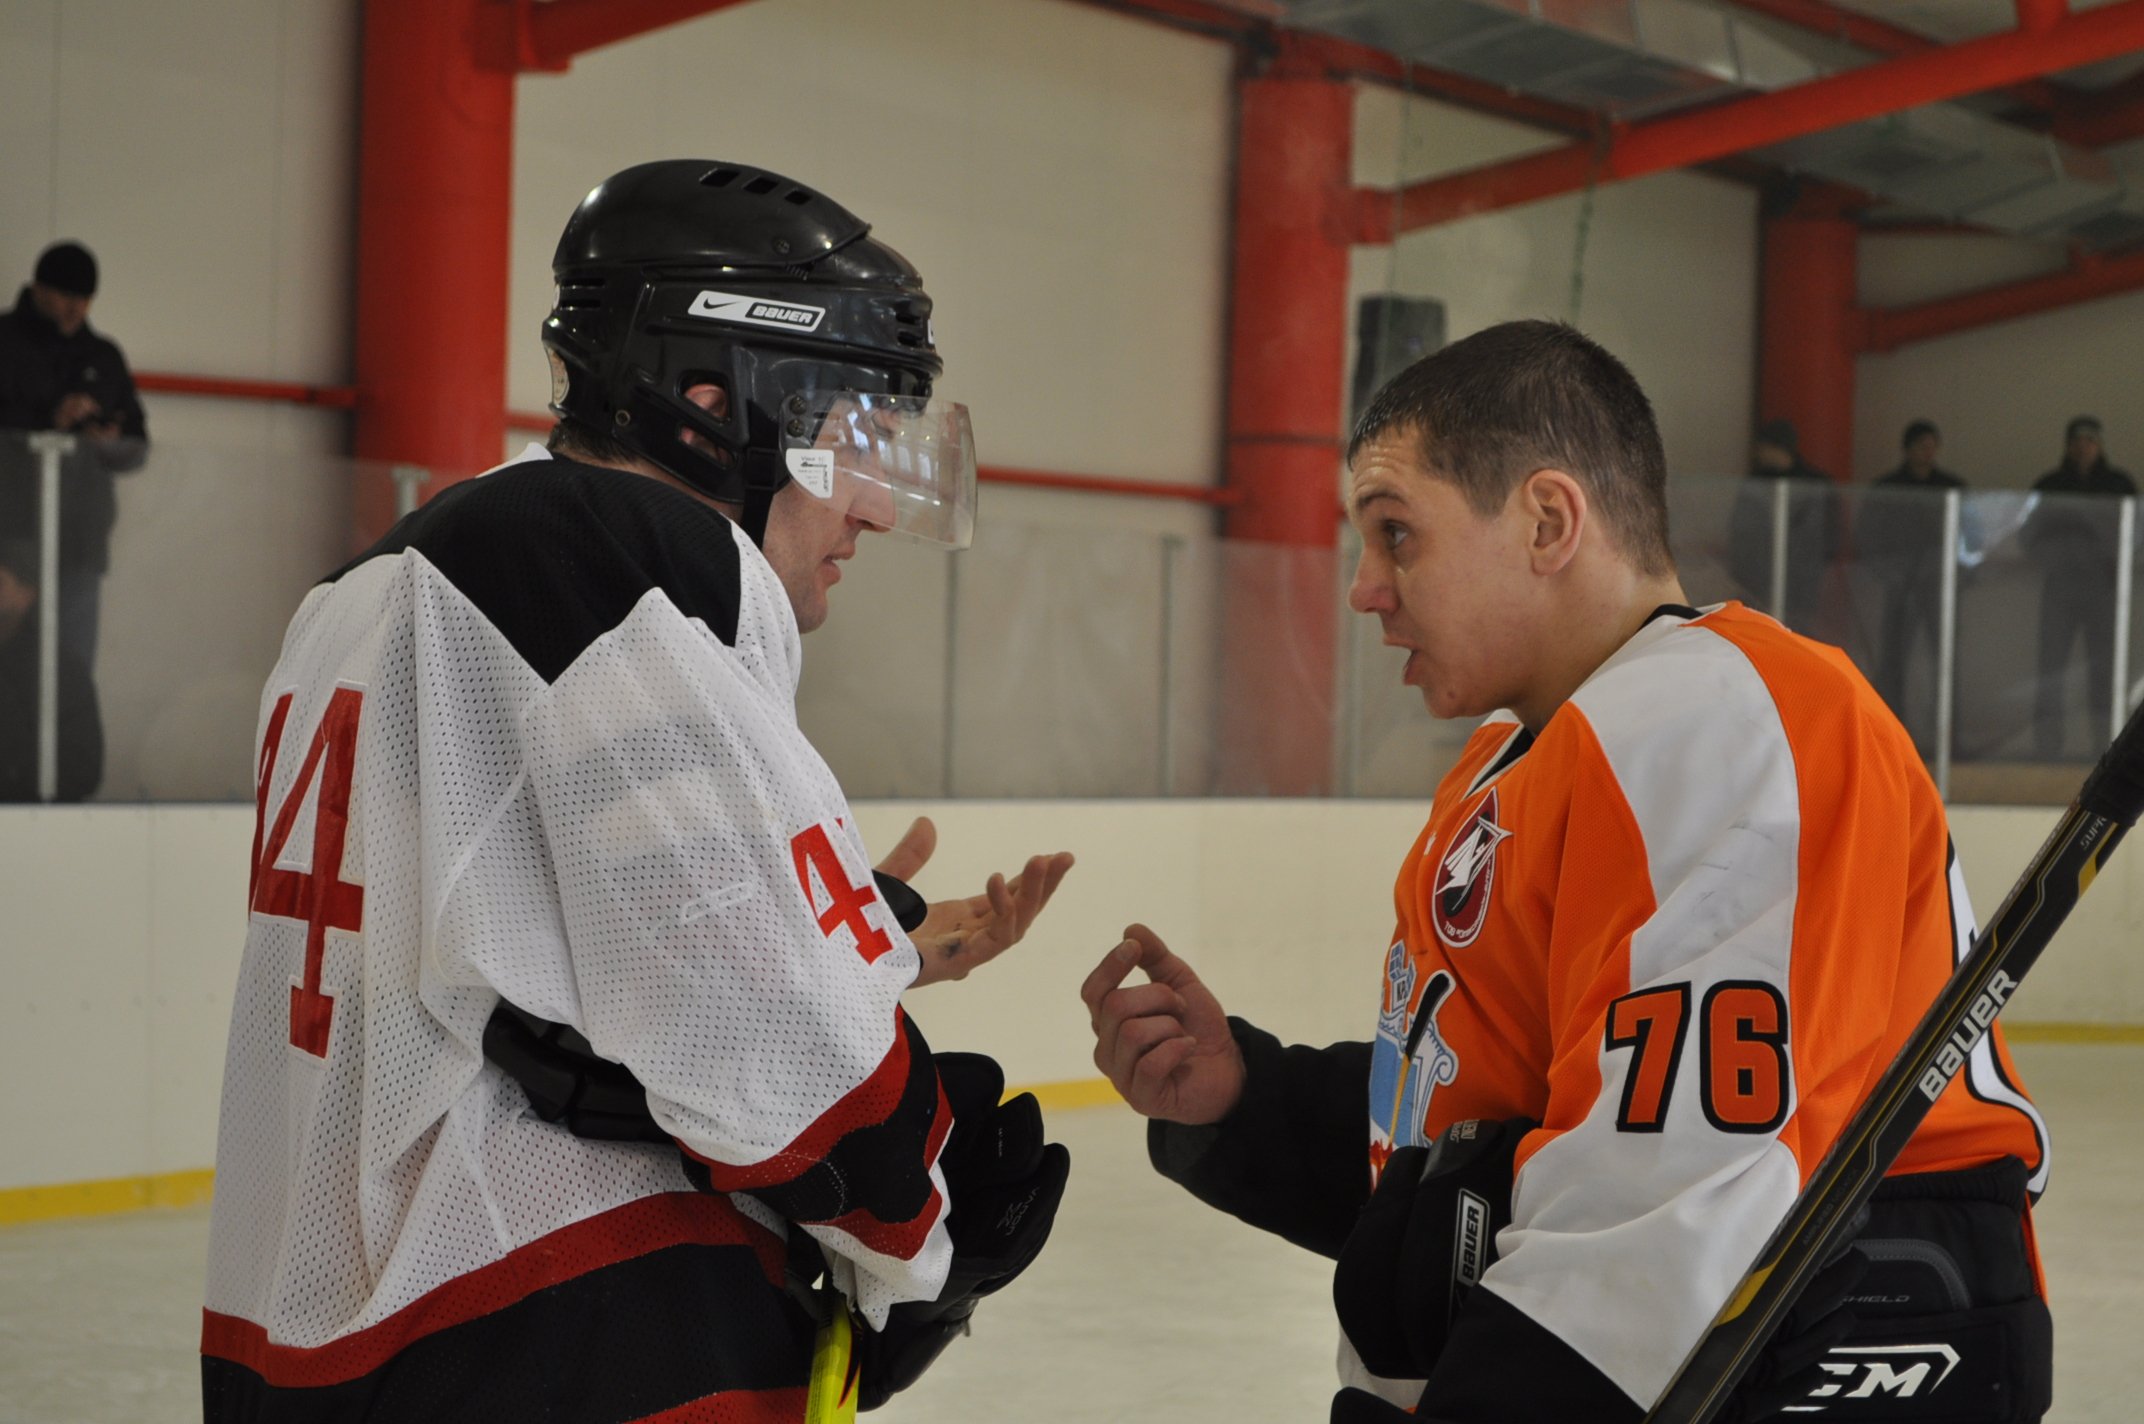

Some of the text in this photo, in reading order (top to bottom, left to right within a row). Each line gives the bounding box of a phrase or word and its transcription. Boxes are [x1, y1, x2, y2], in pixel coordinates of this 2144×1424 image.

[752, 304, 813, 324] BAUER
[790, 818, 894, 967] 4
[1605, 979, 1790, 1135] 76
[1918, 969, 2019, 1103] BAUER
[1462, 1205, 1480, 1280] BAUER
